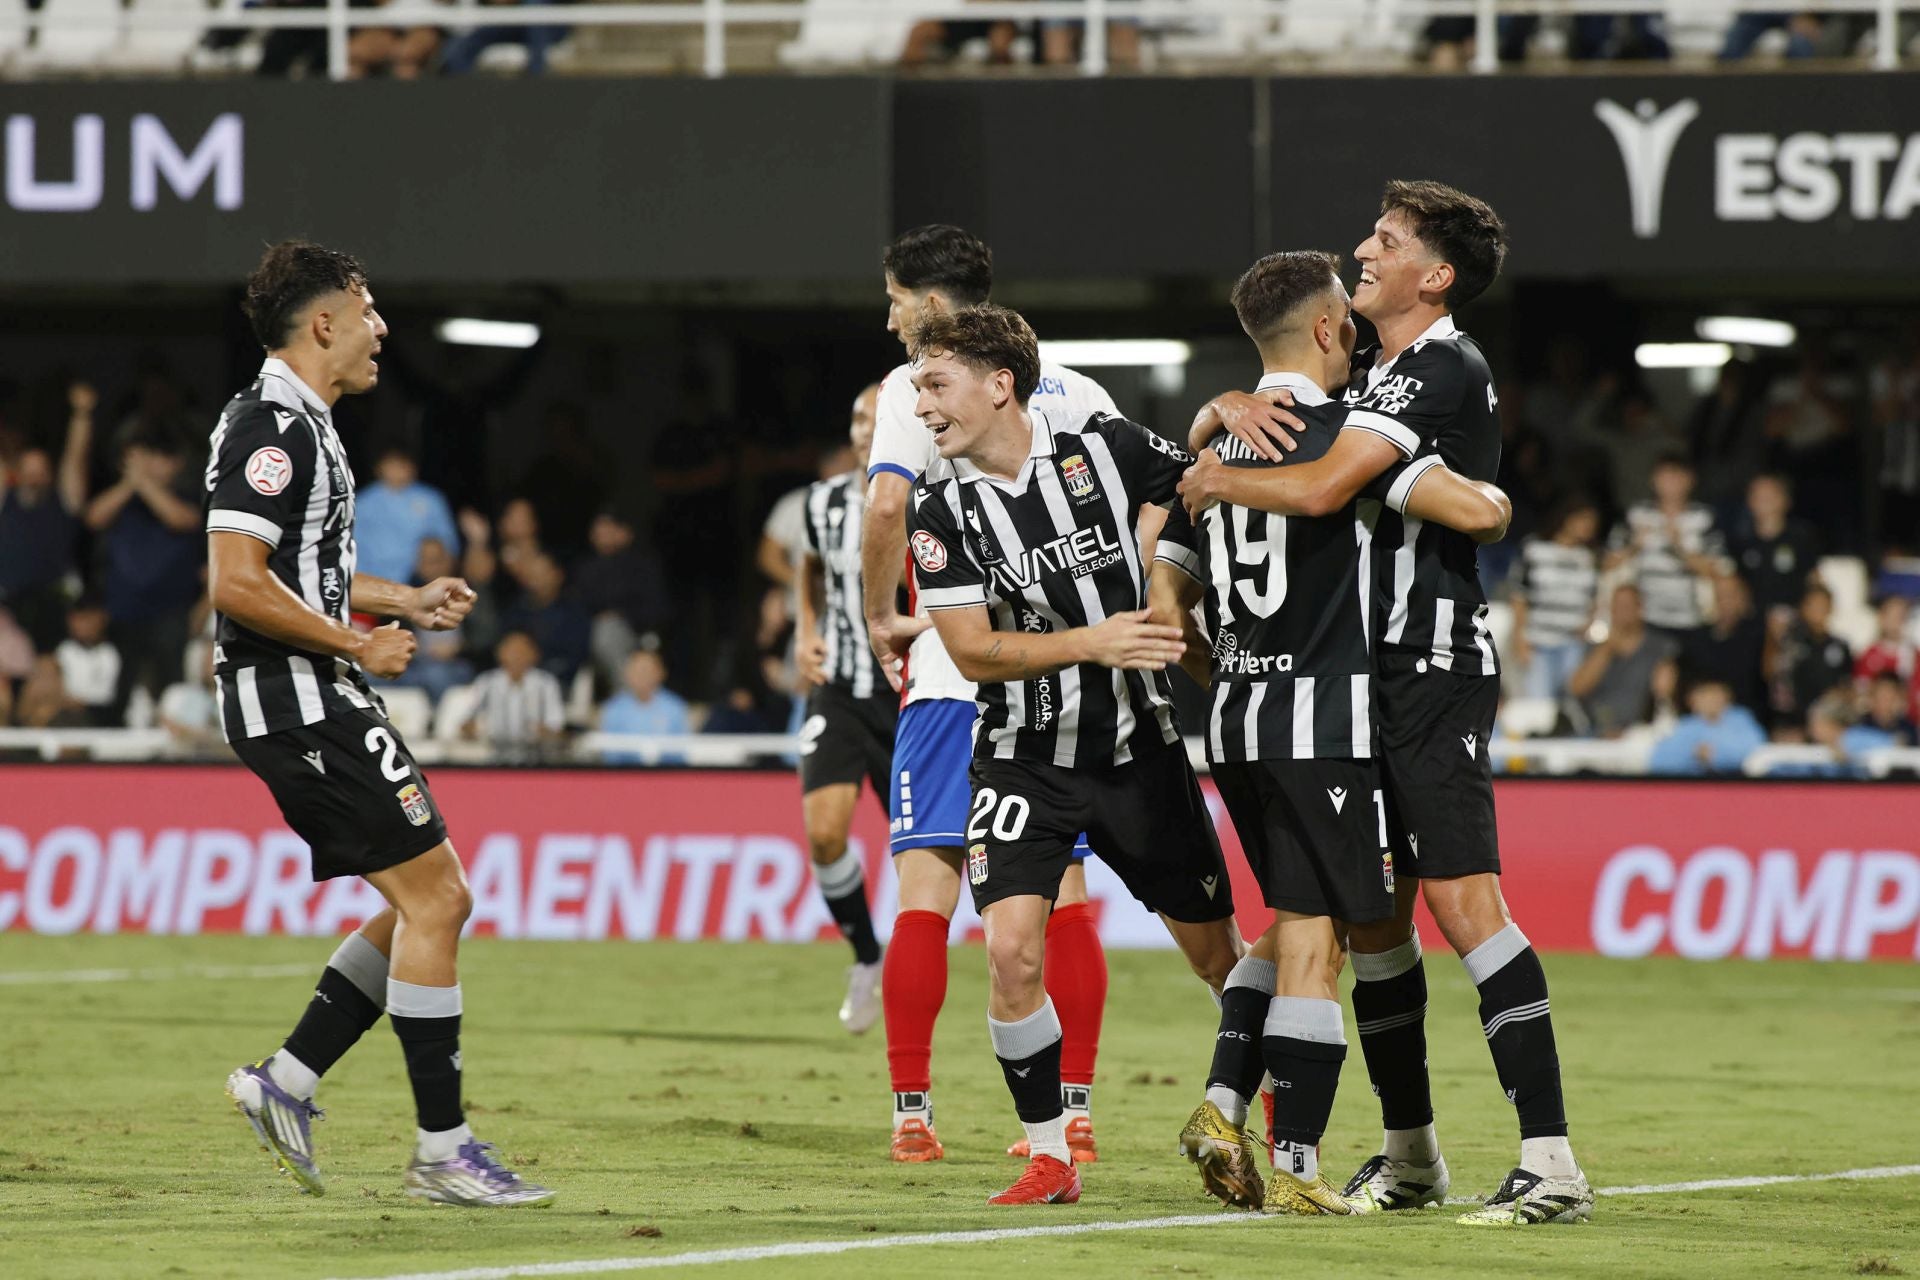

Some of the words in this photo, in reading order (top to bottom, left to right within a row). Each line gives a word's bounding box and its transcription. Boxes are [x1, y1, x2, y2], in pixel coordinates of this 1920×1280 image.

[5, 113, 244, 212] UM
[990, 524, 1120, 593] AVATEL
[1072, 550, 1124, 579] TELECOM
[1202, 500, 1288, 627] 19
[967, 787, 1030, 841] 20
[1590, 845, 1920, 961] COMP
